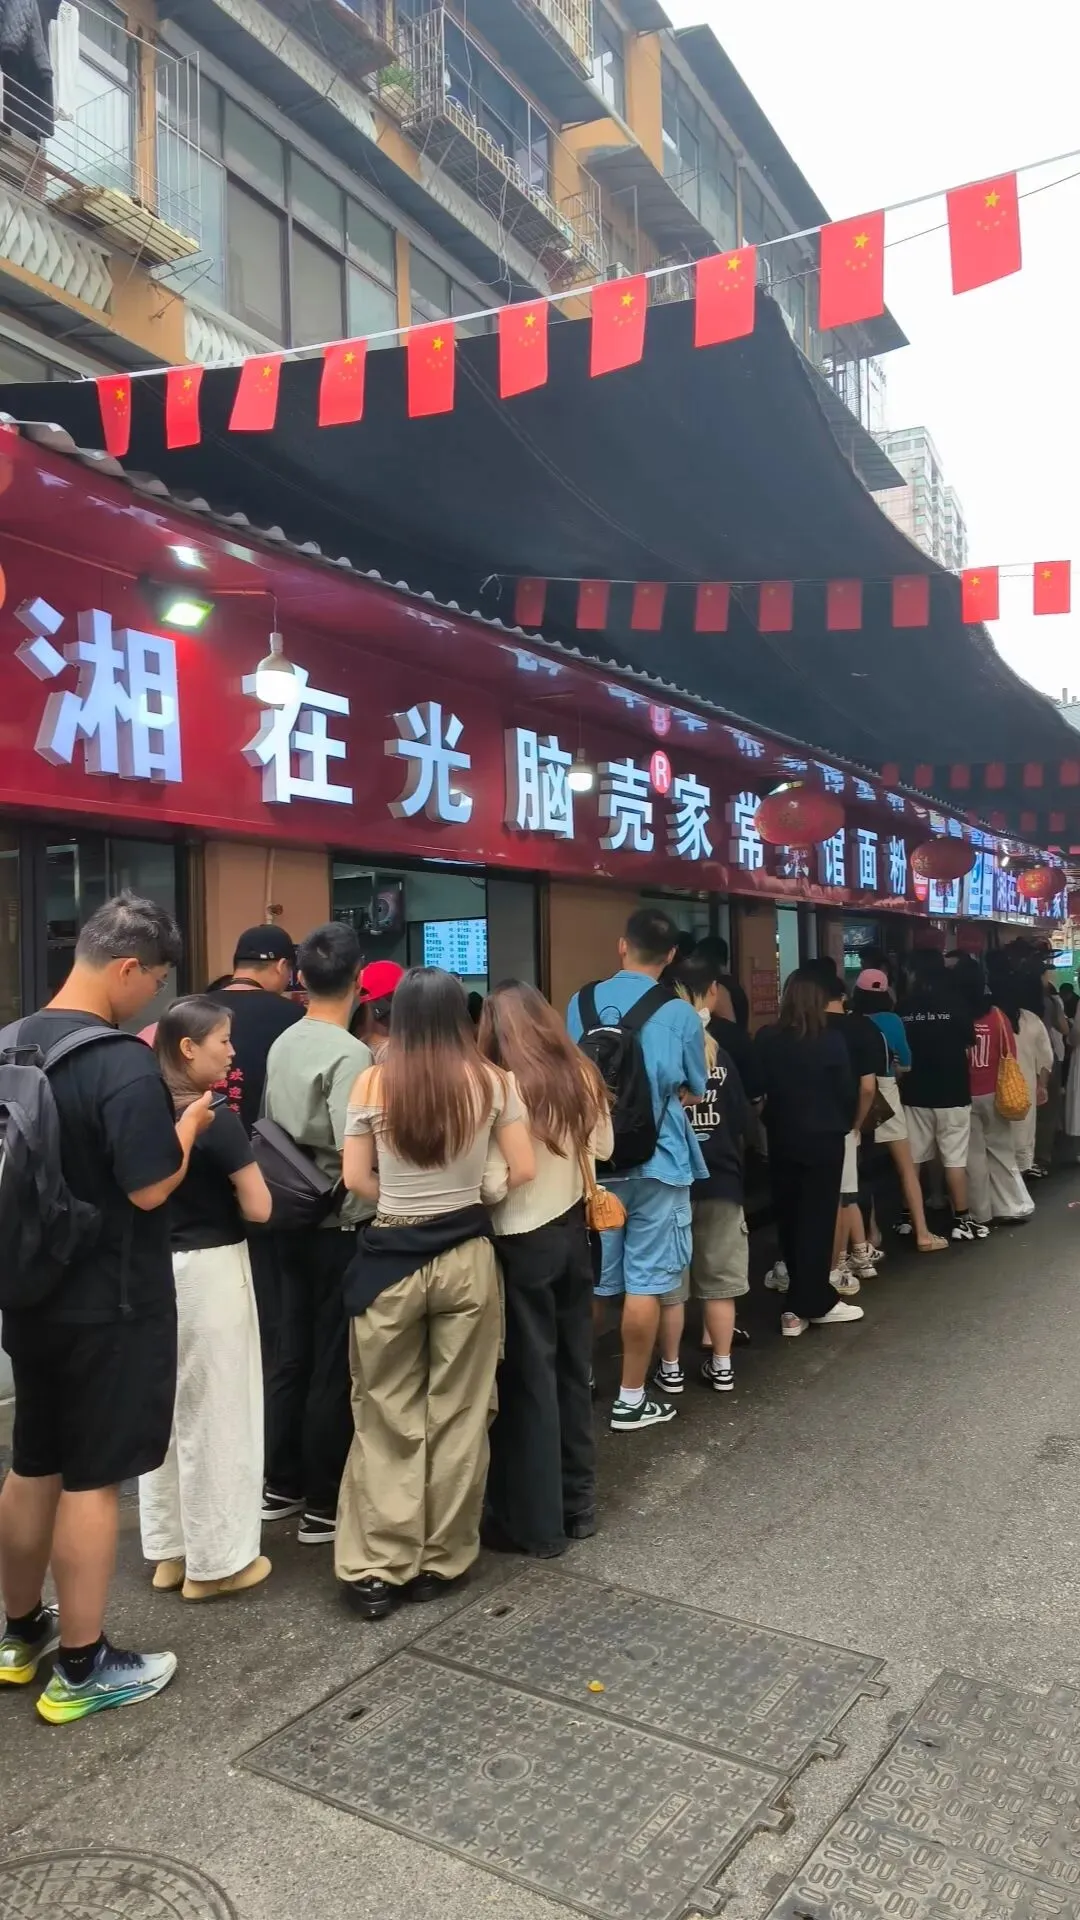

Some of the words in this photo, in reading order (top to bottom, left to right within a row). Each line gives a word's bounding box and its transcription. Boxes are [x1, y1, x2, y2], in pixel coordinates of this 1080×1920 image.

[915, 1012, 925, 1021] de
[928, 1012, 936, 1020] la
[937, 1012, 950, 1020] vie
[683, 1104, 720, 1126] Club
